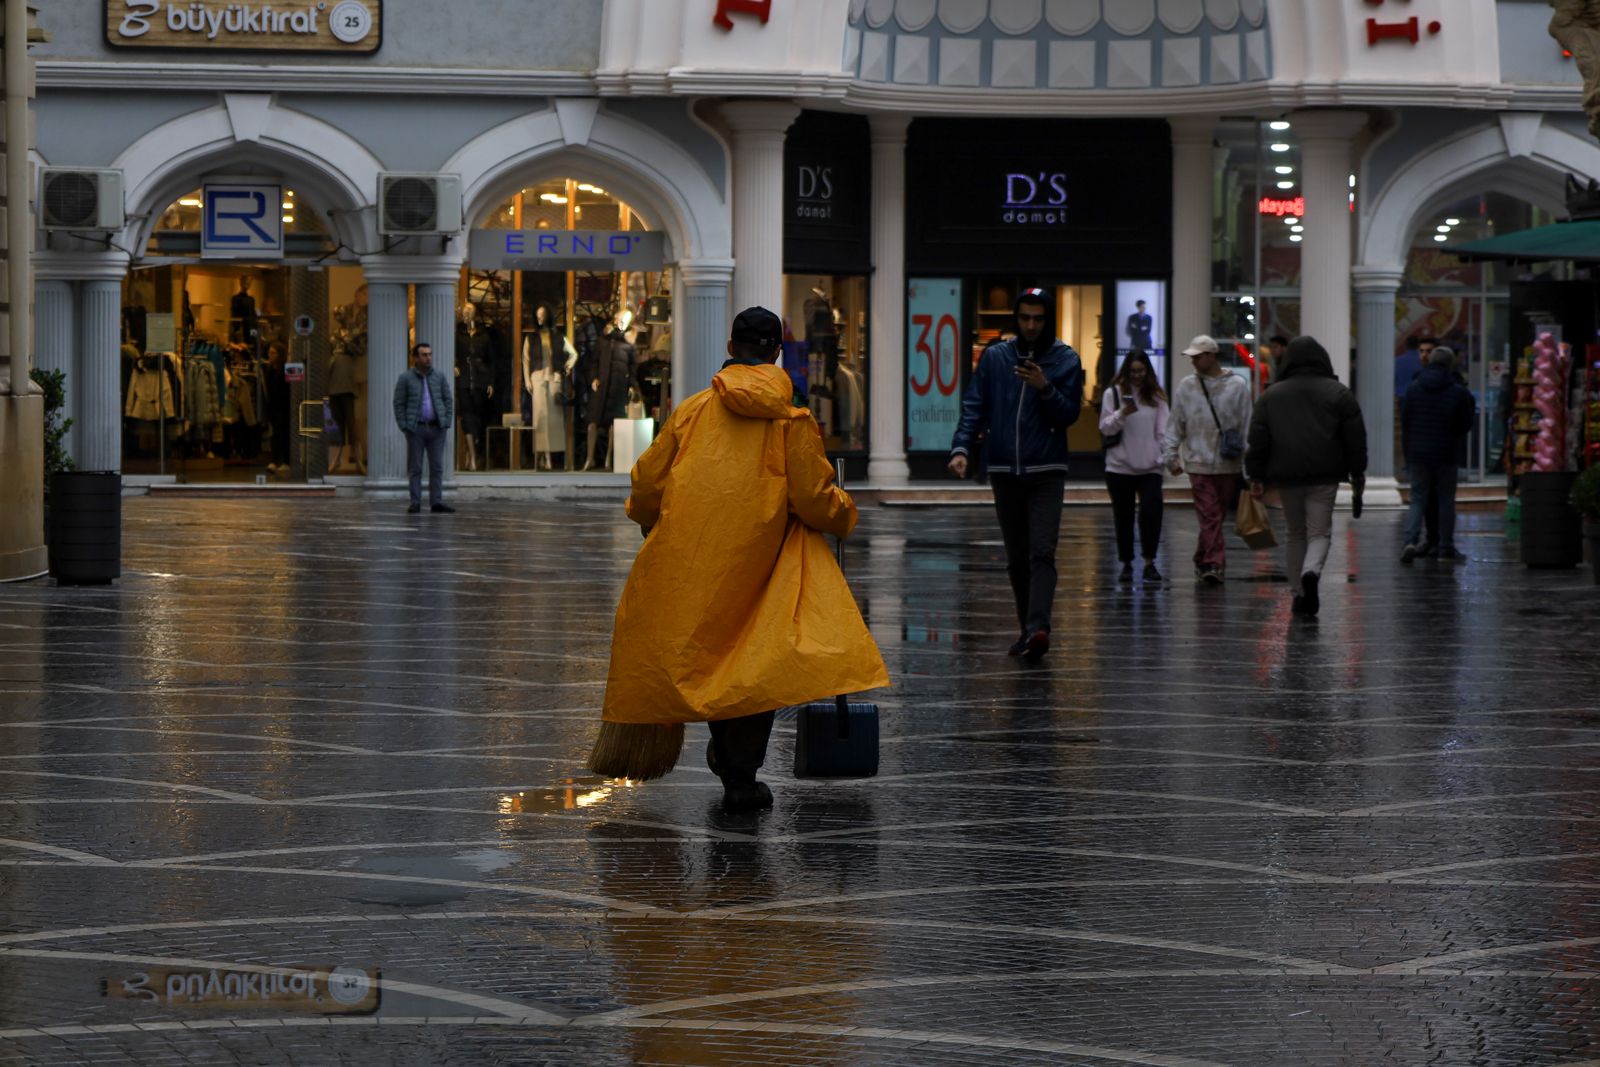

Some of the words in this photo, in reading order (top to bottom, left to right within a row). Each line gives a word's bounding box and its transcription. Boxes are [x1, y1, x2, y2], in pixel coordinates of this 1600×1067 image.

[167, 3, 318, 39] büyükfırat
[344, 16, 360, 28] 25
[797, 164, 833, 199] D'S
[1006, 171, 1067, 205] D'S
[1003, 209, 1066, 224] damat
[911, 313, 960, 397] 30
